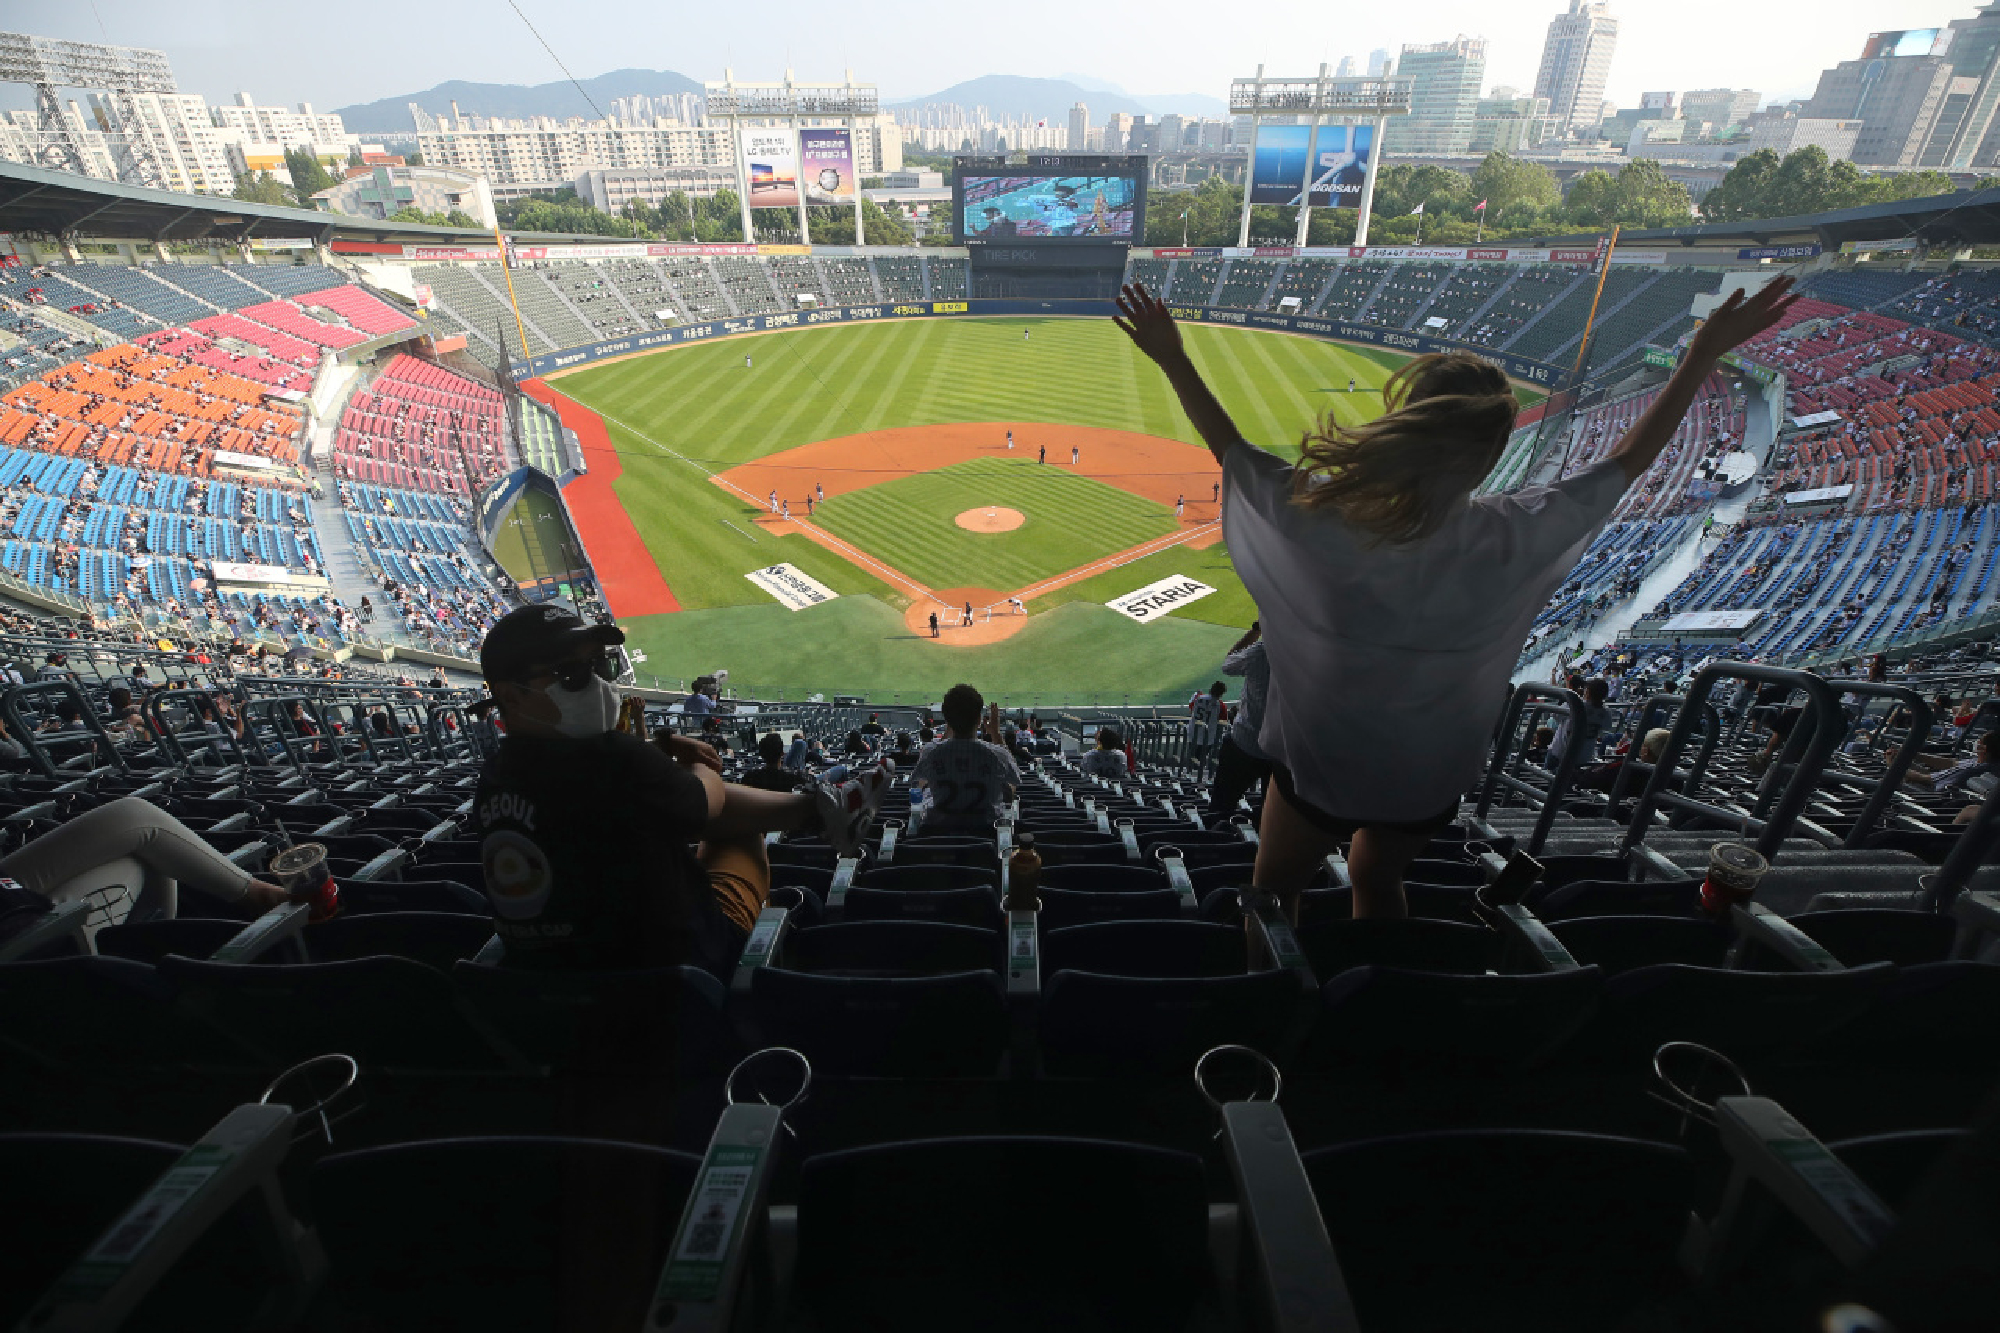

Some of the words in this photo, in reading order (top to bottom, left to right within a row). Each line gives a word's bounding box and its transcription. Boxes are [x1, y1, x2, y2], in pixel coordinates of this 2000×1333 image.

[983, 249, 1009, 260] TIRE
[1012, 249, 1036, 260] PICK
[1127, 583, 1206, 617] STARIA
[480, 791, 536, 832] SEOUL
[937, 779, 988, 815] 22
